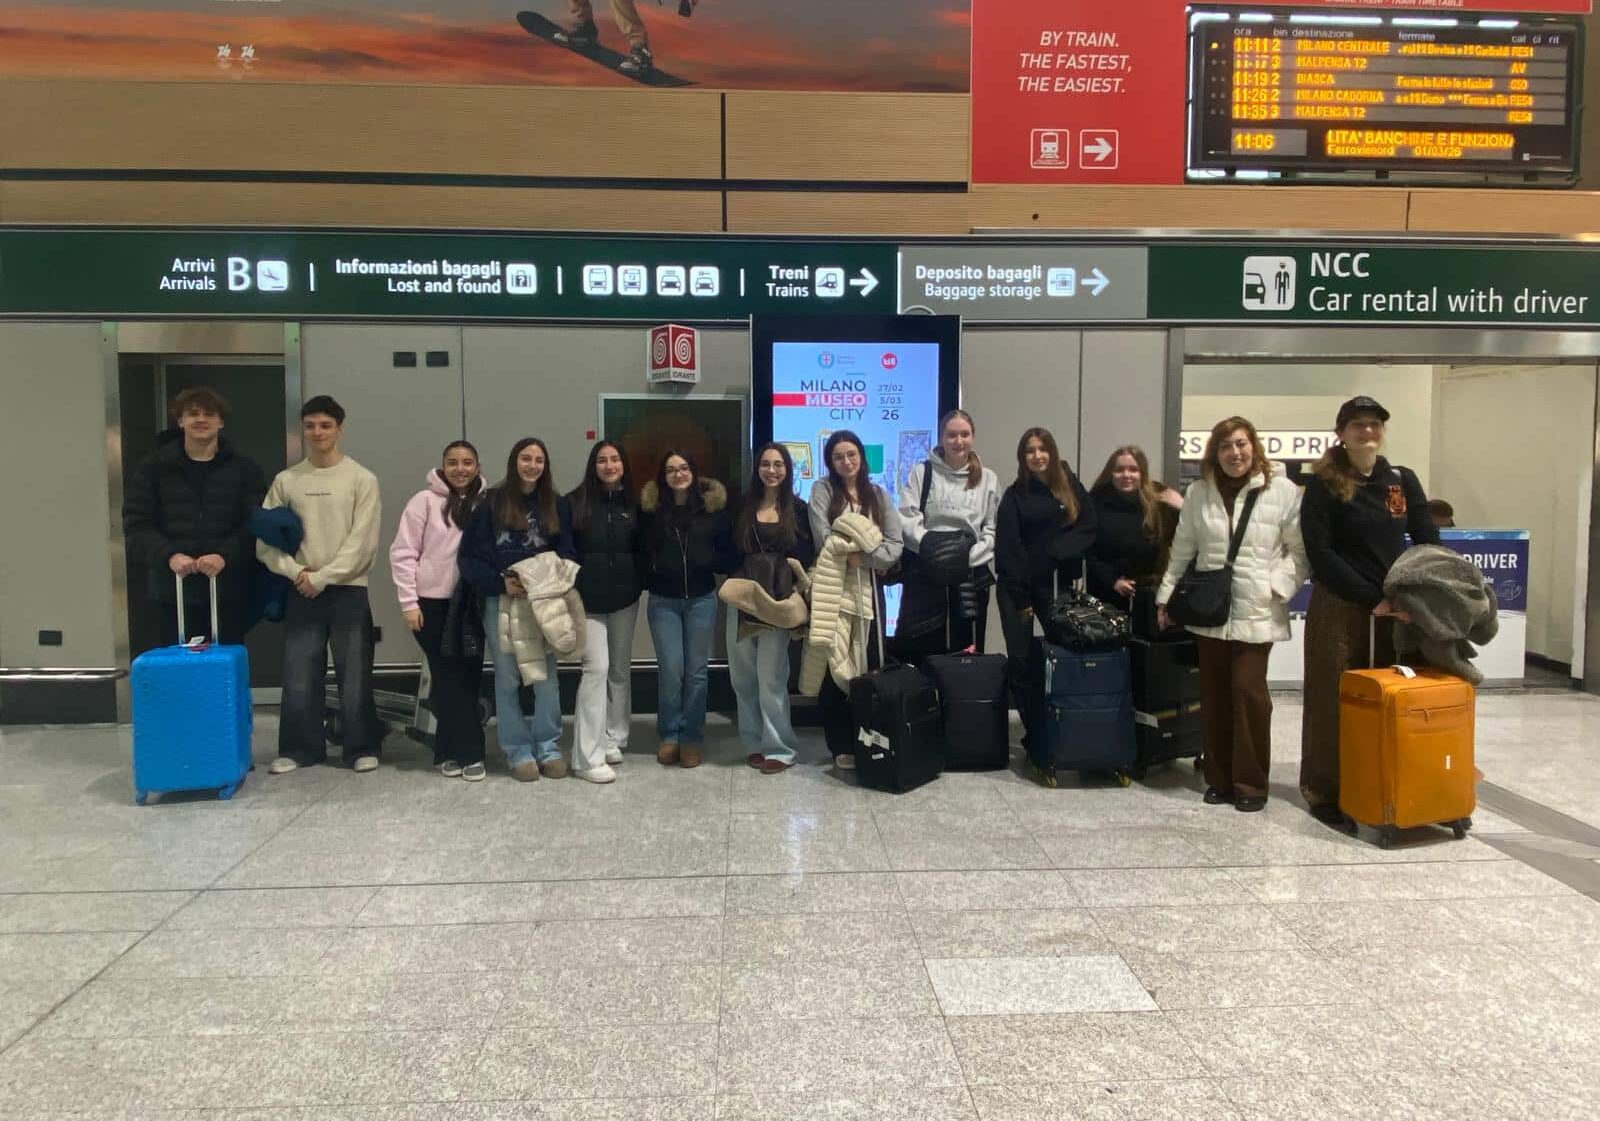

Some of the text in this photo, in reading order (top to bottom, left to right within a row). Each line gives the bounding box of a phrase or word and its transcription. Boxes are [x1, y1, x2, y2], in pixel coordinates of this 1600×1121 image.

[1040, 31, 1119, 47] BY TRAIN.
[1234, 28, 1251, 36] ora
[1273, 28, 1288, 36] bin
[1292, 28, 1354, 38] destinazione
[1398, 32, 1435, 42] fermate
[1233, 38, 1268, 52] 11:11
[1272, 39, 1281, 51] 2
[1296, 40, 1335, 51] MILANO
[1337, 41, 1391, 53] CENTRALE
[1020, 53, 1132, 73] THE FASTEST,
[1272, 56, 1280, 69] 3
[1296, 56, 1351, 68] MALPENSA
[1354, 58, 1368, 68] T2
[1018, 76, 1125, 93] THE EASIEST.
[1233, 71, 1268, 86] 11:19
[1271, 73, 1280, 86] 2
[1296, 73, 1336, 85] BIASCA
[1233, 87, 1268, 102] 11:26
[1271, 89, 1280, 101] 2
[1296, 89, 1333, 100] MILANO
[1336, 90, 1385, 102] CADORNA
[1233, 104, 1268, 119] 11:35
[1270, 104, 1280, 117] 3
[1295, 106, 1350, 117] MALPENSA
[1352, 106, 1366, 118] T2
[1234, 134, 1275, 149] 11:06
[1328, 129, 1362, 144] LITA'
[1365, 130, 1433, 145] BANCHINE
[1437, 133, 1447, 145] E
[1327, 144, 1395, 156] Ferrovienord
[335, 258, 500, 279] Informazioni bagagli
[768, 265, 809, 280] Treni
[1311, 252, 1370, 278] NCC
[172, 256, 251, 291] Arrivi B
[915, 265, 1042, 283] Deposito bagagli
[159, 275, 216, 290] Arrivals
[388, 277, 501, 294] Lost and found
[766, 283, 809, 298] Trains
[925, 283, 1042, 300] Baggage storage
[1309, 286, 1589, 314] Car rental with driver
[800, 380, 866, 392] MILANO
[805, 393, 866, 406] MUSEO
[830, 408, 864, 420] CITY
[882, 409, 899, 420] 26
